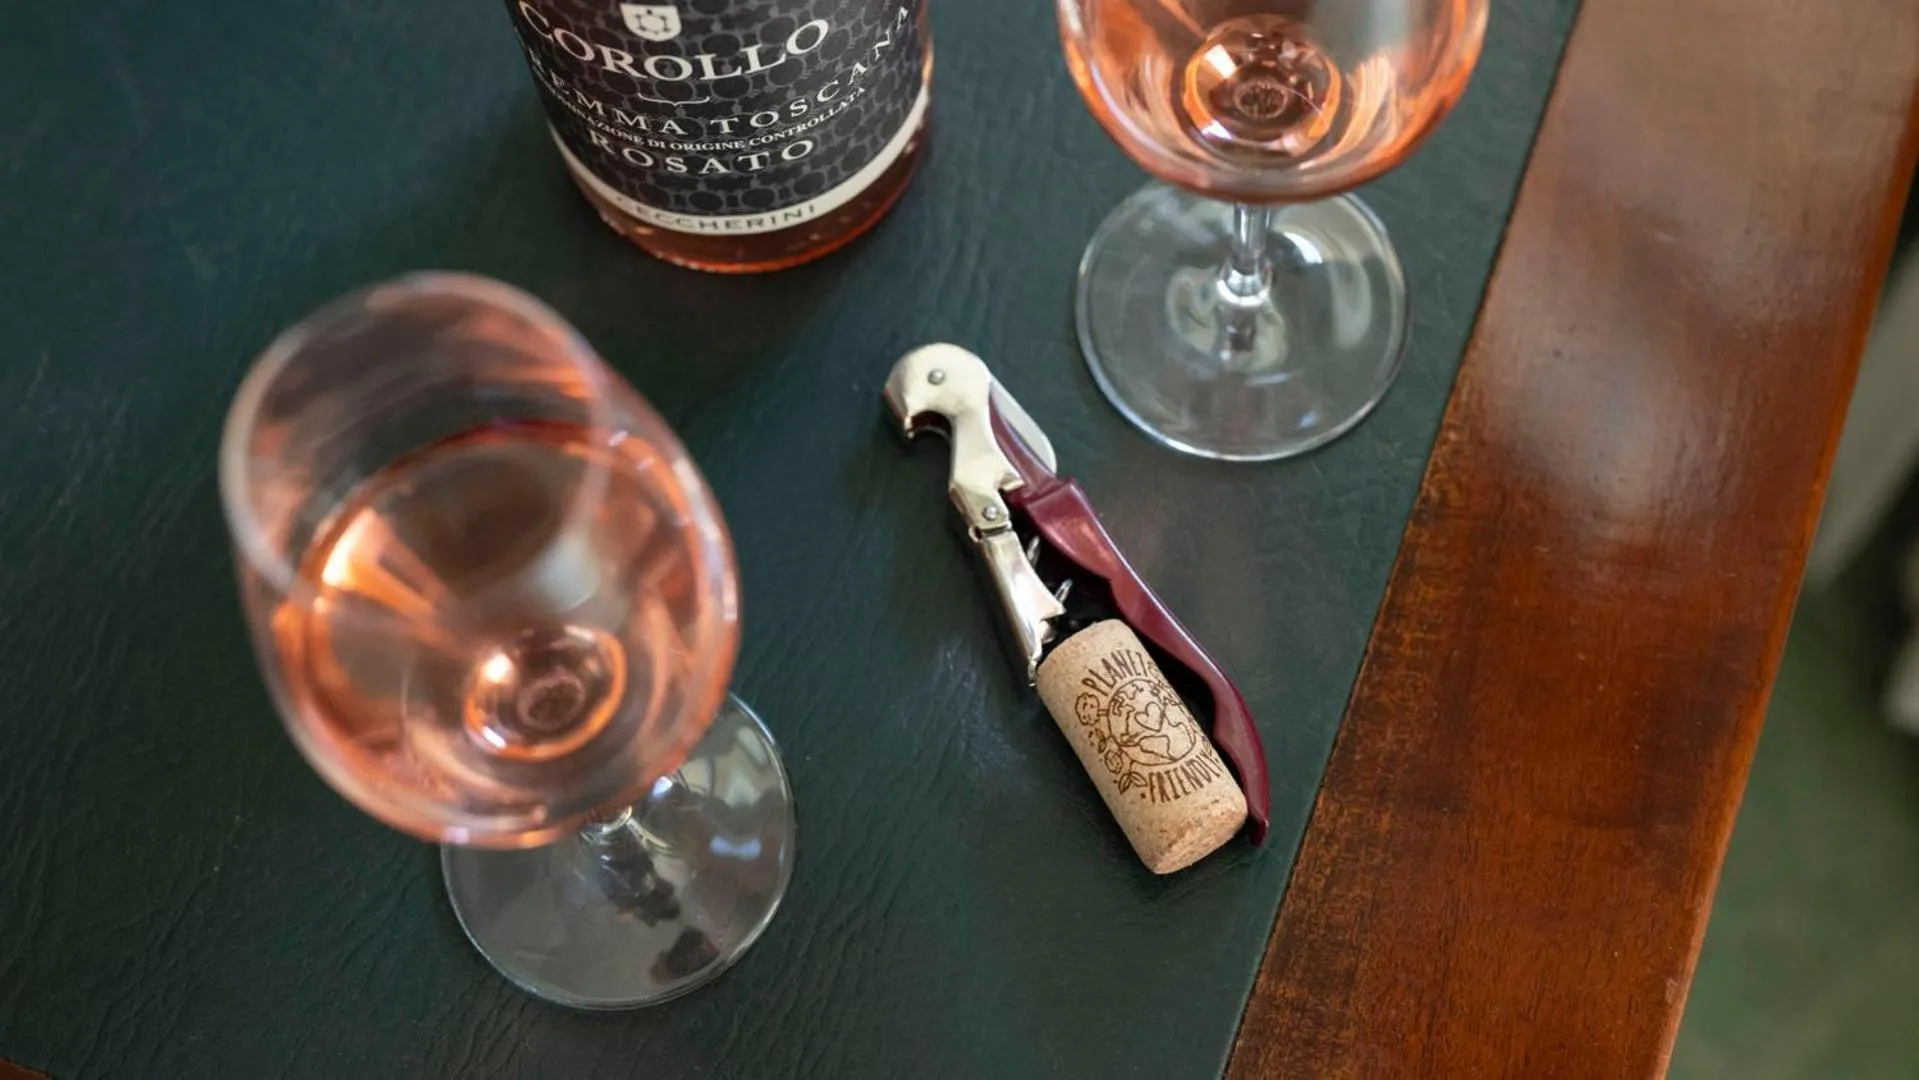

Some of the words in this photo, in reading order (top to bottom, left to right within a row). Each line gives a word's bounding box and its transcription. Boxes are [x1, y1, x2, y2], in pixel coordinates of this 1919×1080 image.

[519, 1, 829, 82] COROLLO
[710, 6, 909, 134] TOSCANA
[648, 139, 667, 150] DI
[671, 139, 746, 152] ORIGINE
[749, 87, 866, 146] CONTROLLATA
[588, 129, 814, 175] ROSATO
[1081, 649, 1148, 697] PLANET
[1148, 750, 1224, 804] FRIENDLY
